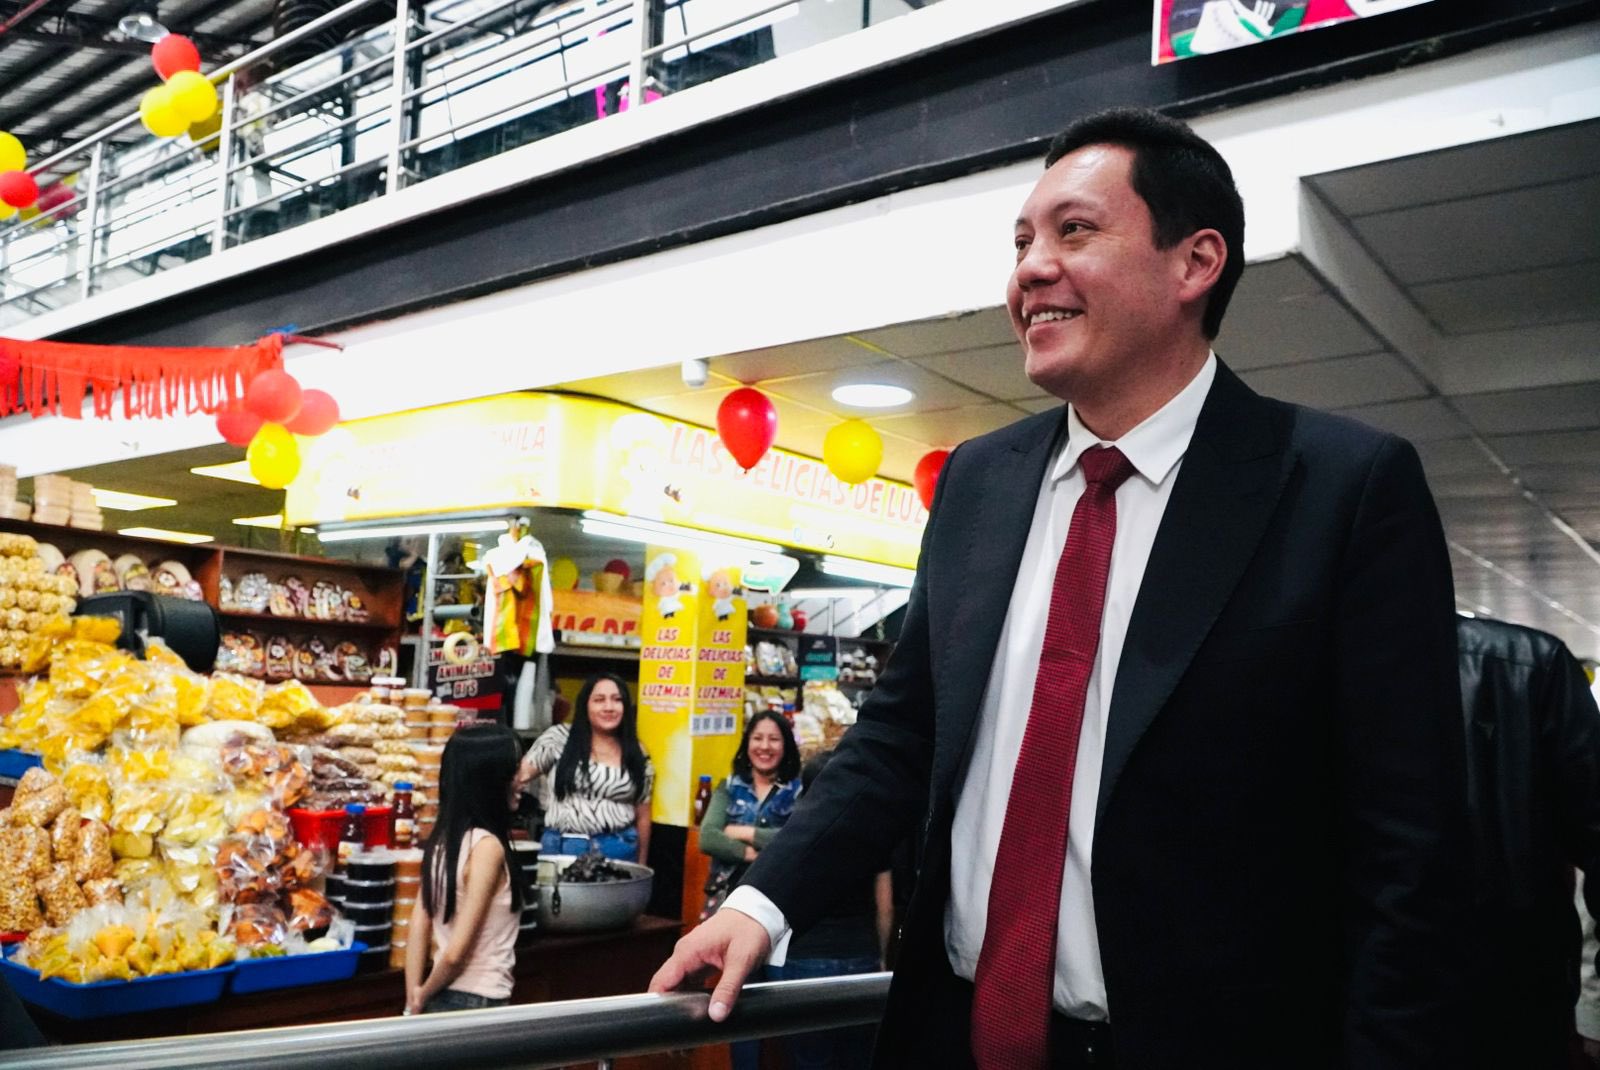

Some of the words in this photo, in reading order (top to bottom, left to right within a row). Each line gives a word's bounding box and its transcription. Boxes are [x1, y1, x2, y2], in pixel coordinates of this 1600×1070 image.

[669, 426, 725, 475] LAS
[854, 482, 884, 514] DE
[657, 628, 678, 642] LAS
[712, 630, 731, 644] LAS
[642, 646, 692, 661] DELICIAS
[698, 647, 743, 662] DELICIAS
[657, 665, 674, 679] DE
[713, 667, 728, 681] DE
[641, 684, 690, 699] LUZMILA
[697, 686, 743, 700] LUZMILA
